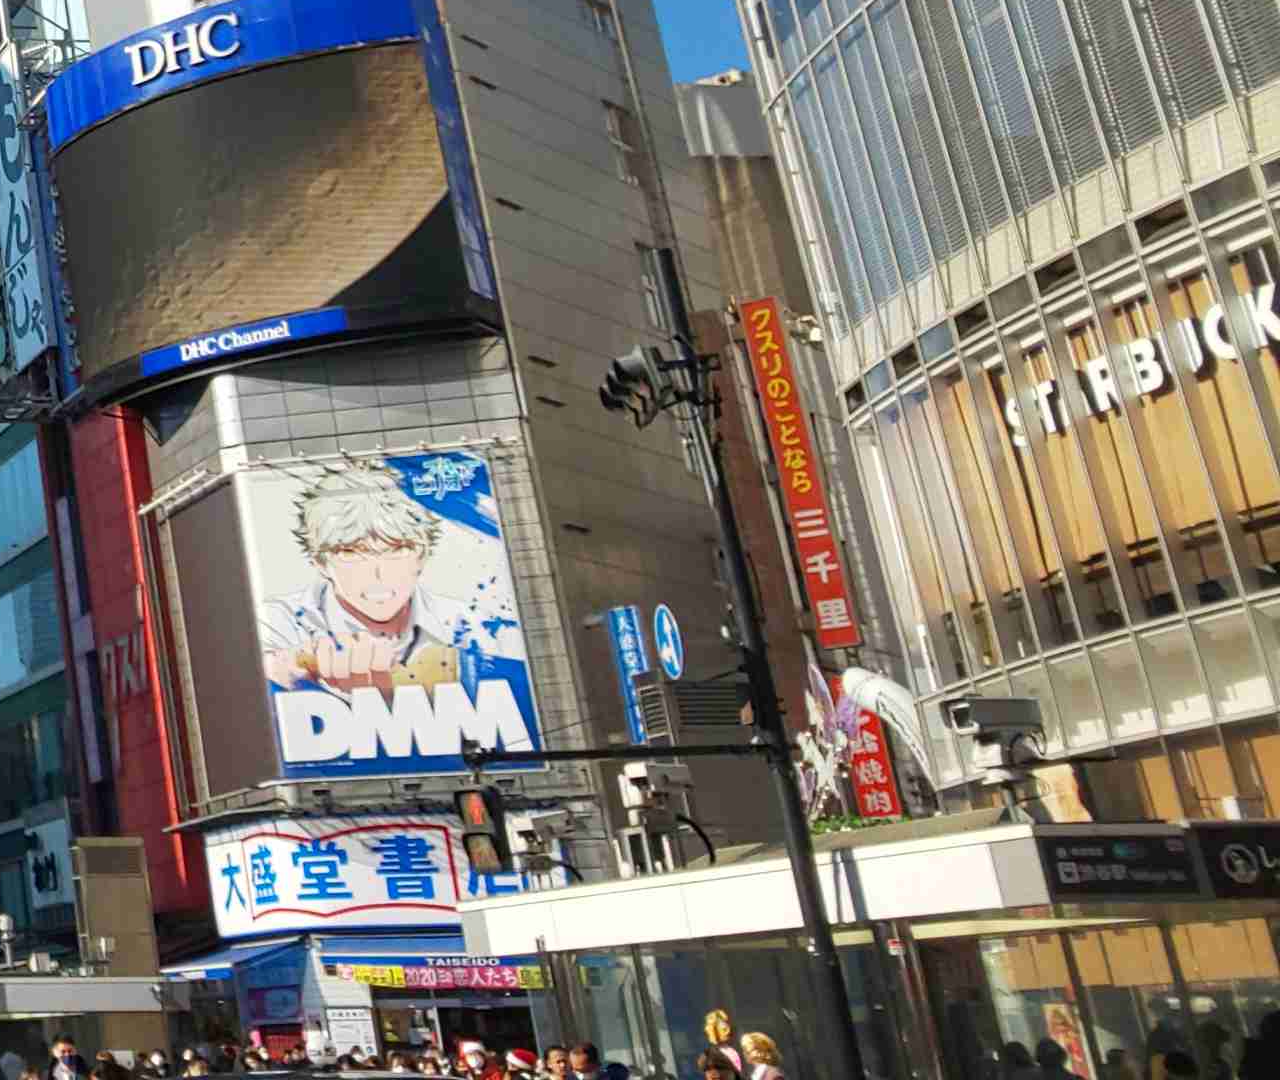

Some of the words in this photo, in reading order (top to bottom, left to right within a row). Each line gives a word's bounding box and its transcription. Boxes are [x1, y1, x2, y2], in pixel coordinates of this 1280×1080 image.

[124, 12, 240, 88] DHC
[180, 338, 218, 362] DHC
[218, 321, 290, 354] Channel
[1005, 282, 1280, 447] STRBCK
[752, 308, 811, 494] クスリのことなら
[794, 508, 852, 629] 三千里
[275, 679, 535, 762] DMM
[426, 958, 500, 967] TAISEIDO
